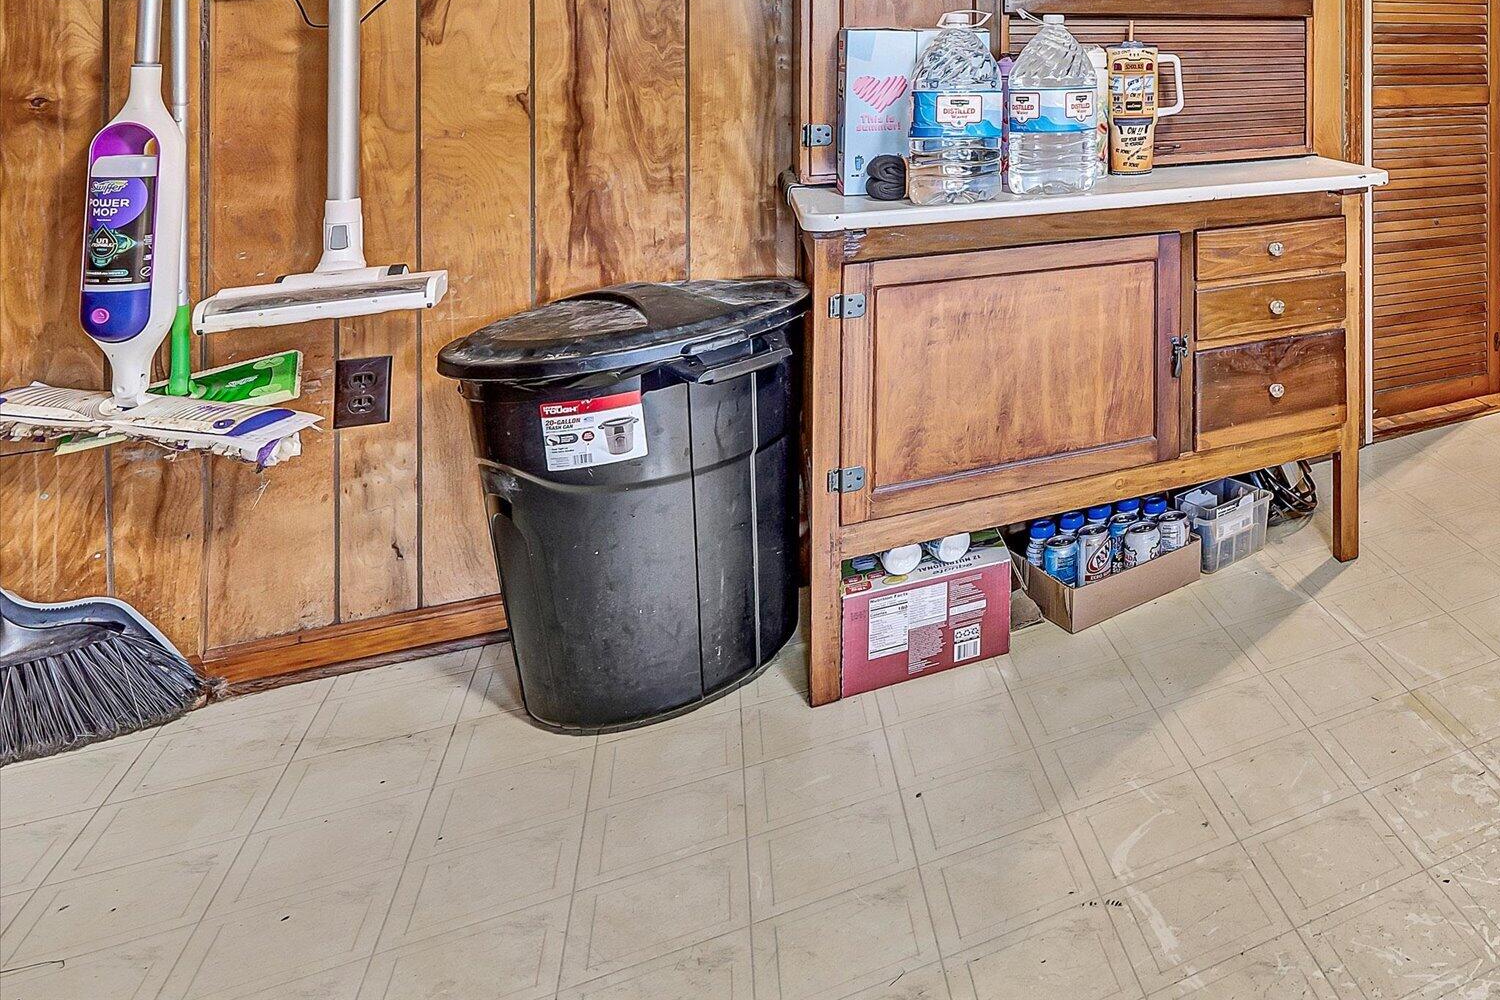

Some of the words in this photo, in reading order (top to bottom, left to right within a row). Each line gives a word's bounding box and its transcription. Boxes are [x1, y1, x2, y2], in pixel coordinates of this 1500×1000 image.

[943, 107, 975, 115] DISTILLED
[91, 180, 128, 195] Swiffer
[92, 208, 118, 216] MOP
[545, 418, 580, 427] 20-GALLON
